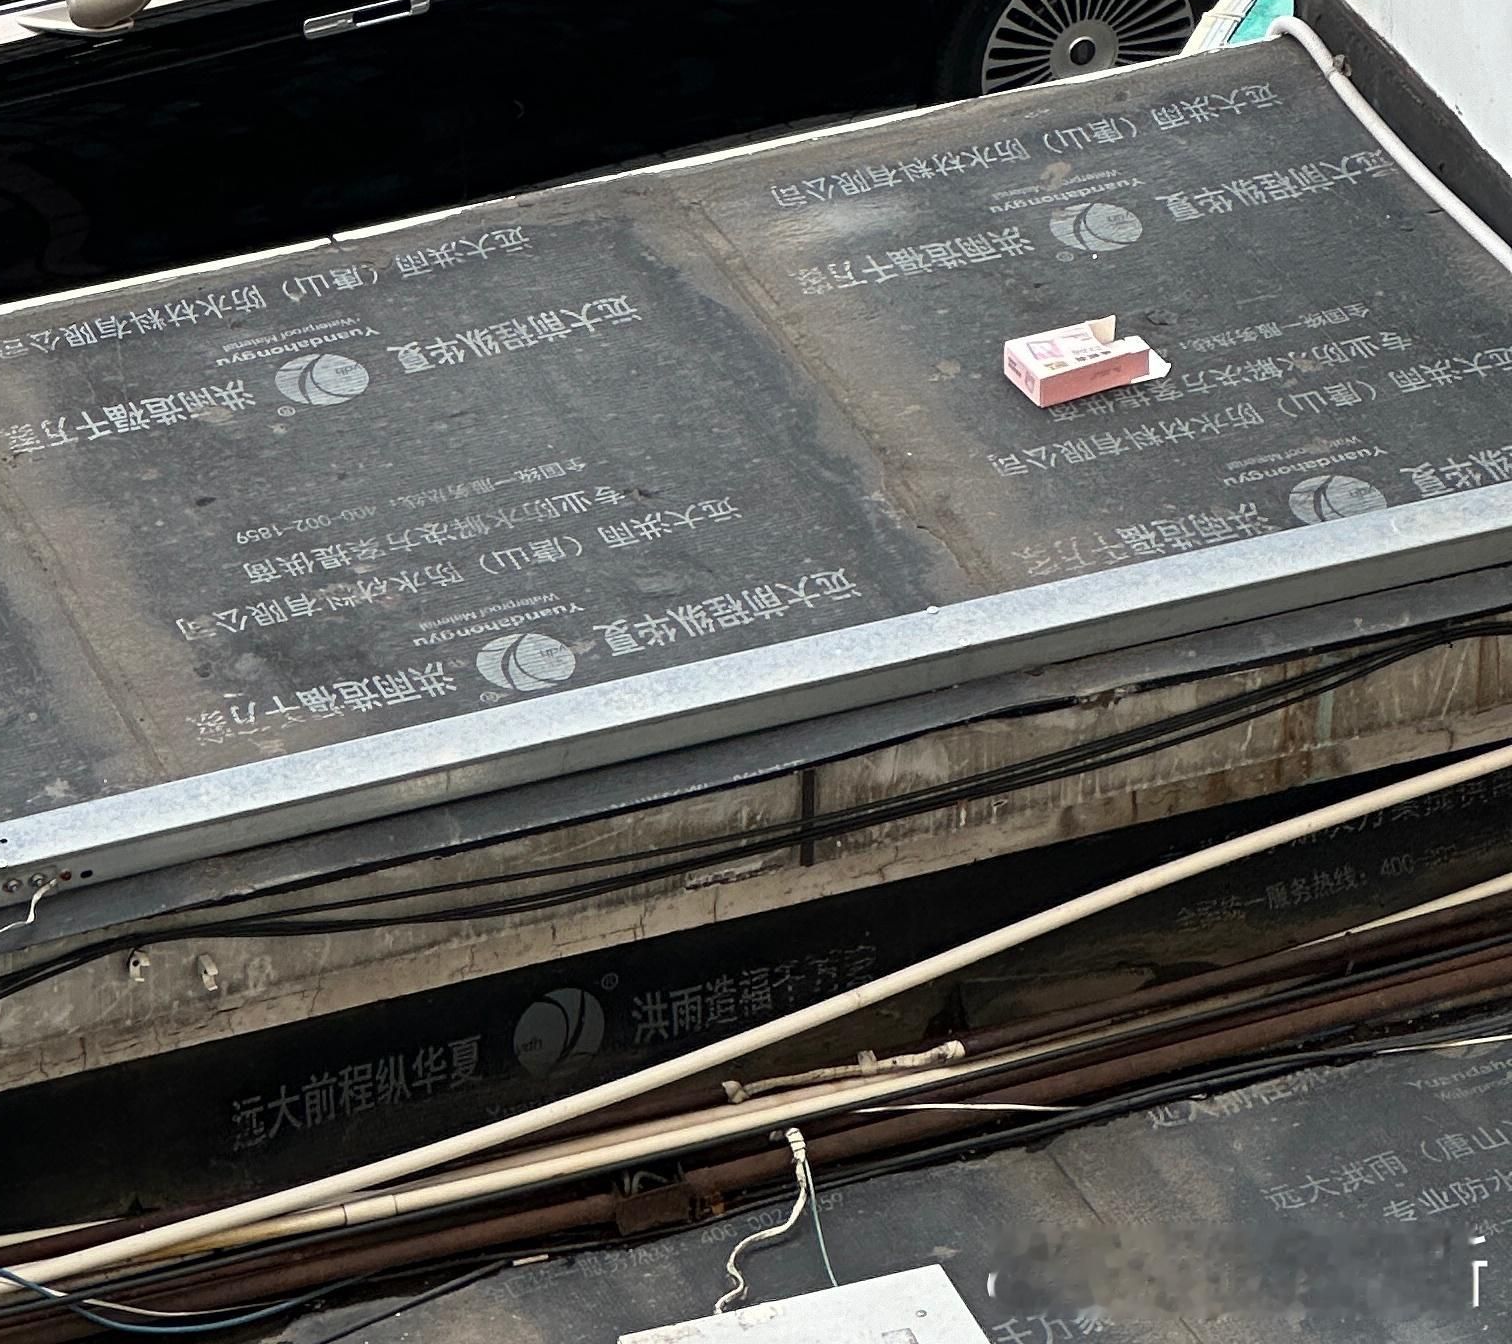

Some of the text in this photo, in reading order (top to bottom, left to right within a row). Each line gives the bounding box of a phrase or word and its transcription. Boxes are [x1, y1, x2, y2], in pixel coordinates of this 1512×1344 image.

[215, 325, 380, 367] Yuandahongyu
[387, 295, 642, 373] 远大前程纵华夏
[1223, 445, 1387, 487] Yuandahongyu
[412, 601, 584, 647] Yuandahongyu
[593, 568, 861, 656] 远大前程纵华夏
